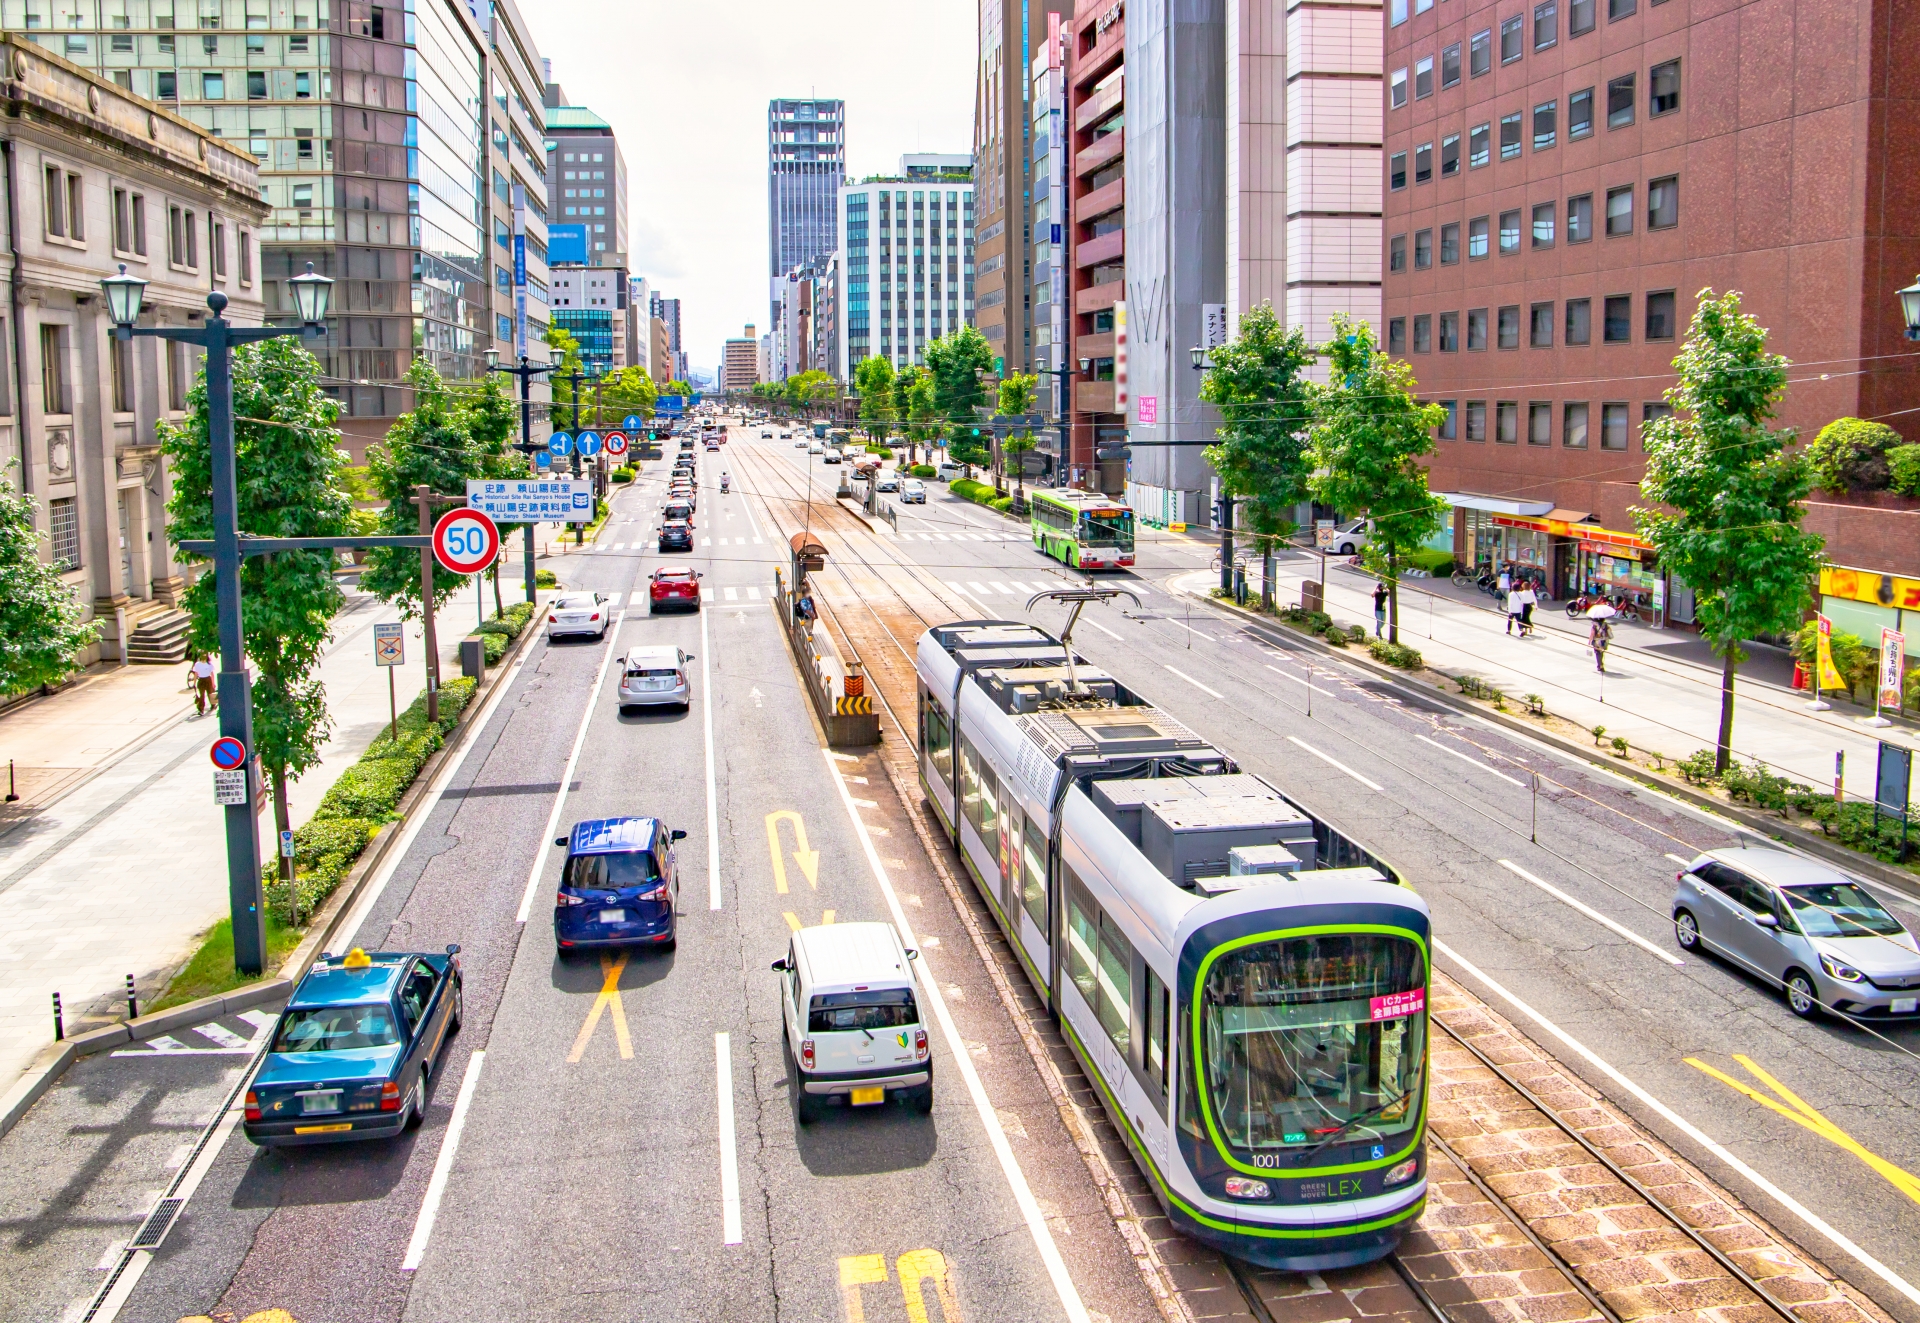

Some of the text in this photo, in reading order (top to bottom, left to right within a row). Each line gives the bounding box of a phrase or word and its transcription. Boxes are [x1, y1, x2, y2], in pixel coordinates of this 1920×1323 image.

[485, 483, 506, 494] 史跡
[448, 526, 484, 555] 50
[1382, 992, 1416, 1006] ICカード
[1251, 1154, 1280, 1168] 1001
[1300, 1183, 1326, 1191] GREEN
[1301, 1190, 1326, 1198] MOVER
[1327, 1178, 1362, 1197] LEX
